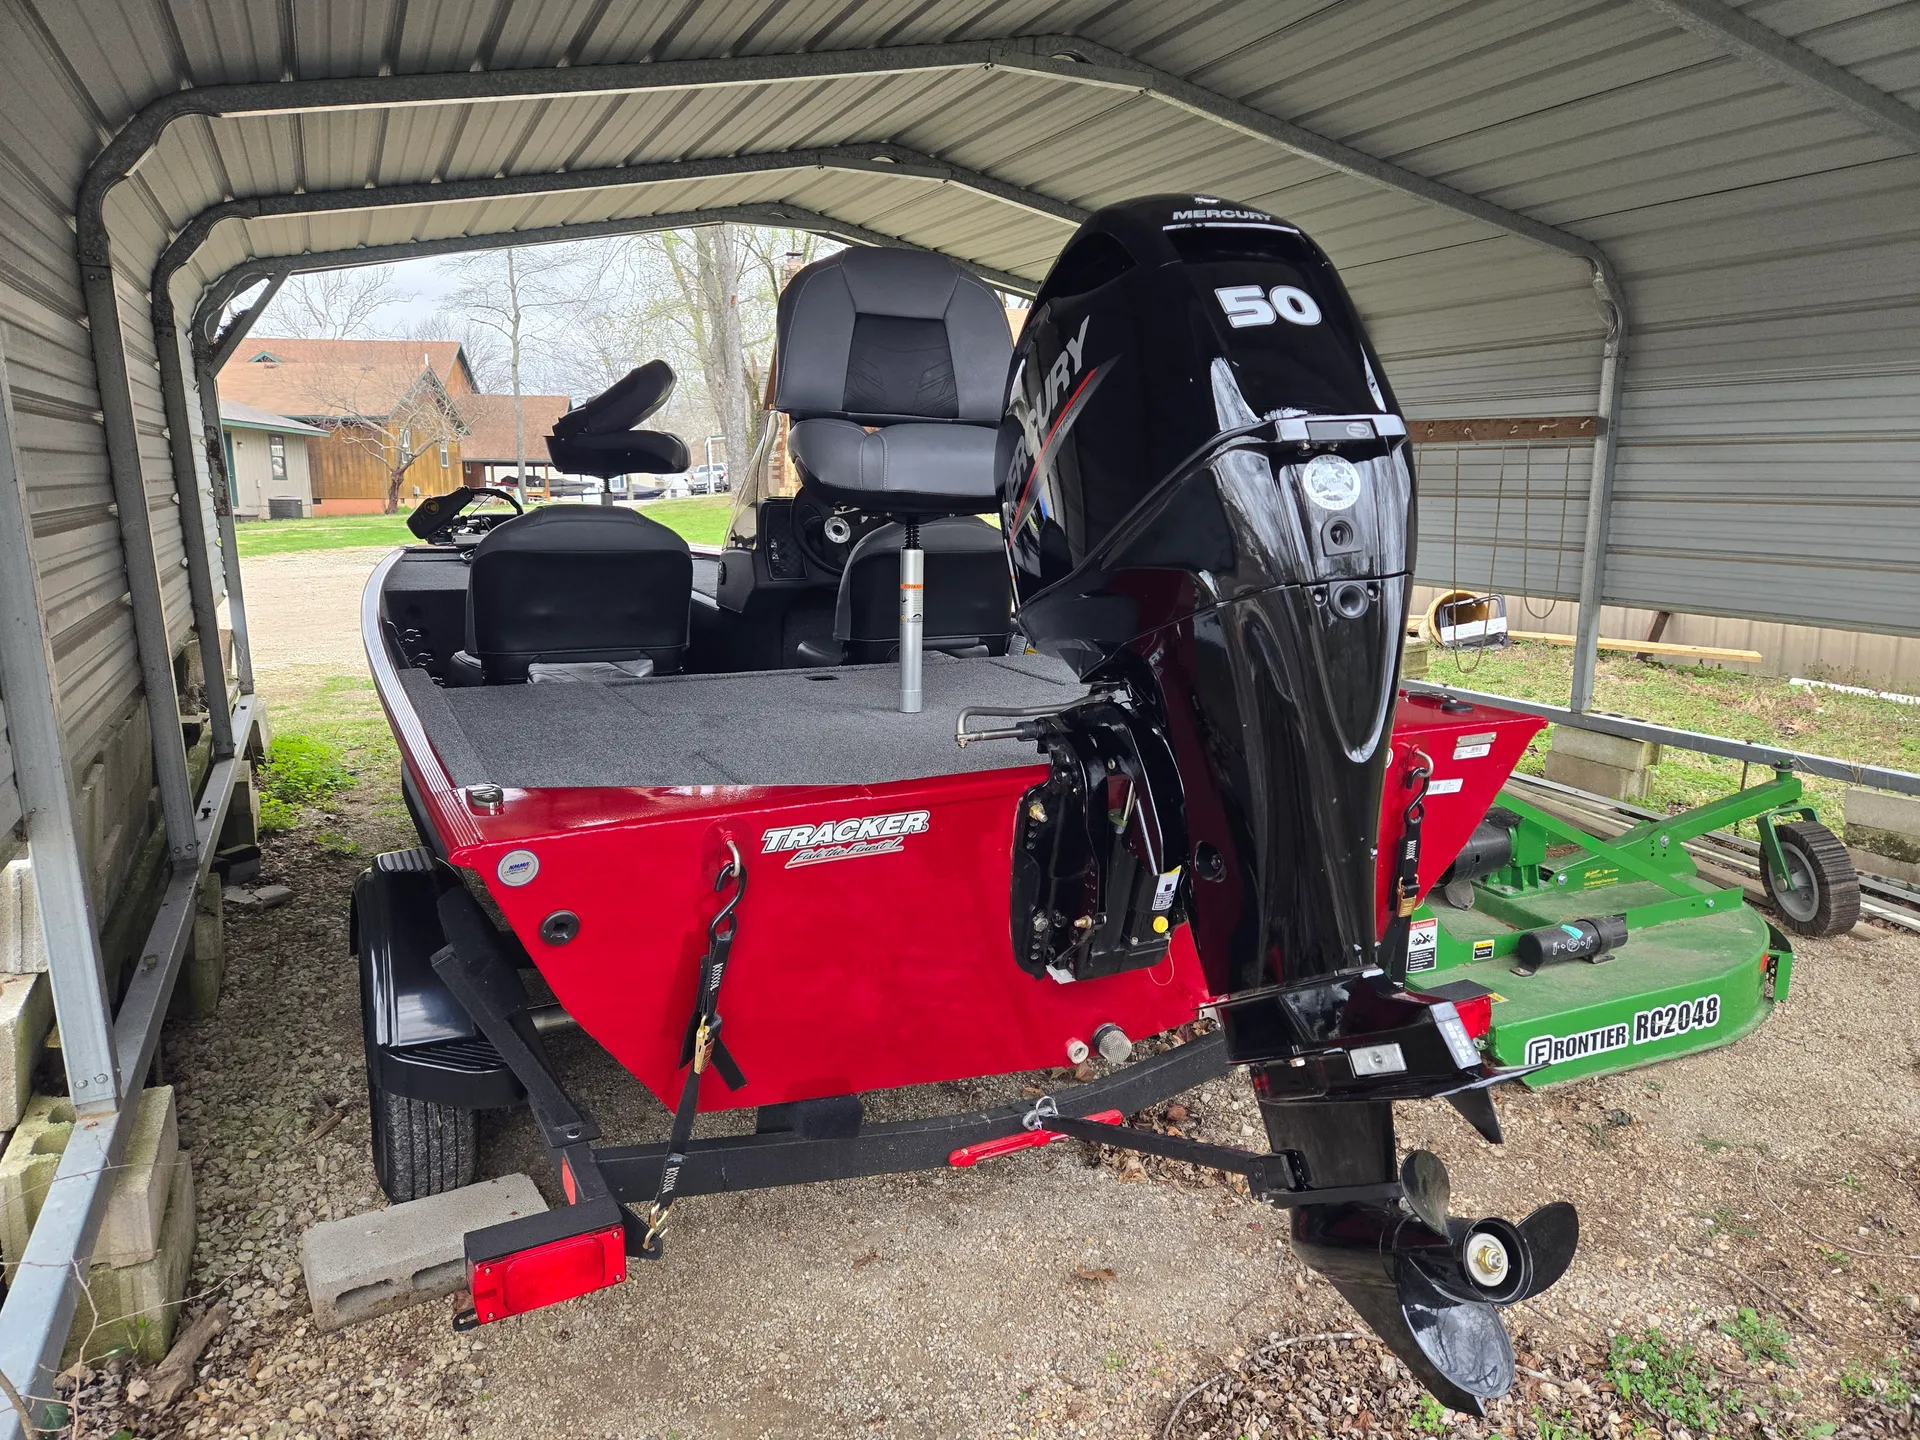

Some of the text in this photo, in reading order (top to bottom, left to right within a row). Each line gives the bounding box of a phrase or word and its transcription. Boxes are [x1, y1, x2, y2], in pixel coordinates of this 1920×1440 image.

[1173, 209, 1272, 221] MERCURY
[1214, 285, 1322, 329] 50
[763, 811, 929, 852] TRACKER
[792, 848, 824, 862] Fish
[824, 846, 845, 857] the
[1528, 997, 1718, 1066] FRONTIER RC2048
